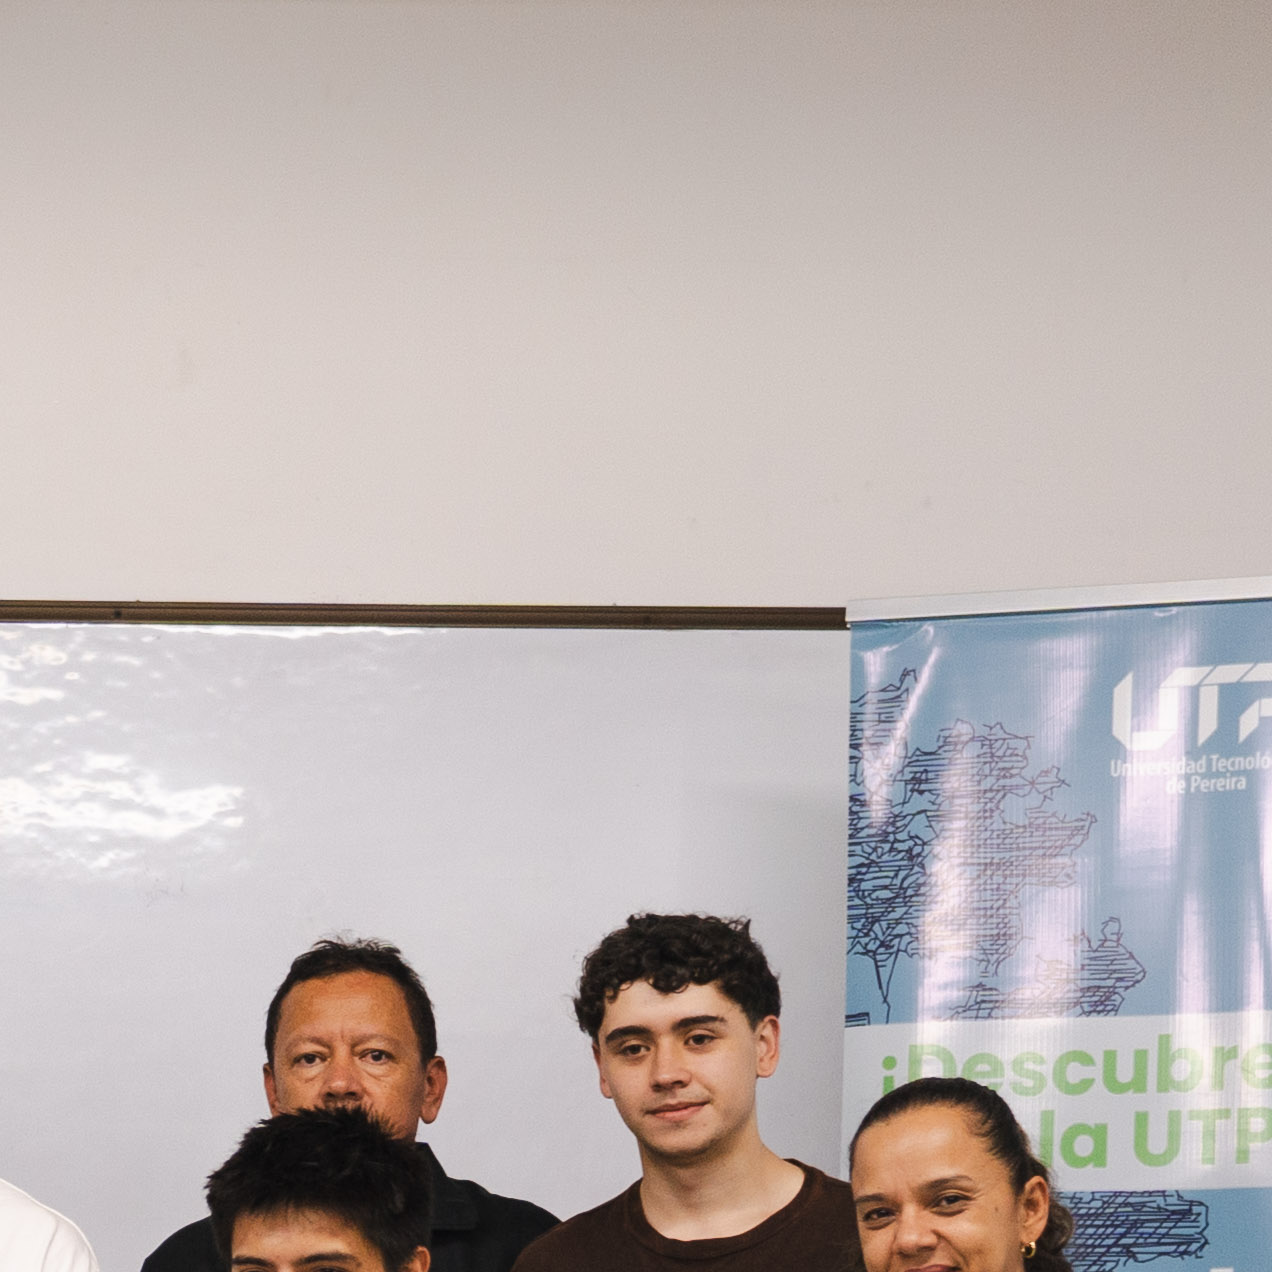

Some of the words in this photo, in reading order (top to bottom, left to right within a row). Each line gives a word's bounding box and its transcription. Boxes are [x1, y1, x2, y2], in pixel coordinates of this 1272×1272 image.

[1110, 755, 1207, 778] Universidad
[1166, 776, 1186, 795] de
[1190, 774, 1247, 793] Pereira
[1038, 1109, 1109, 1169] la
